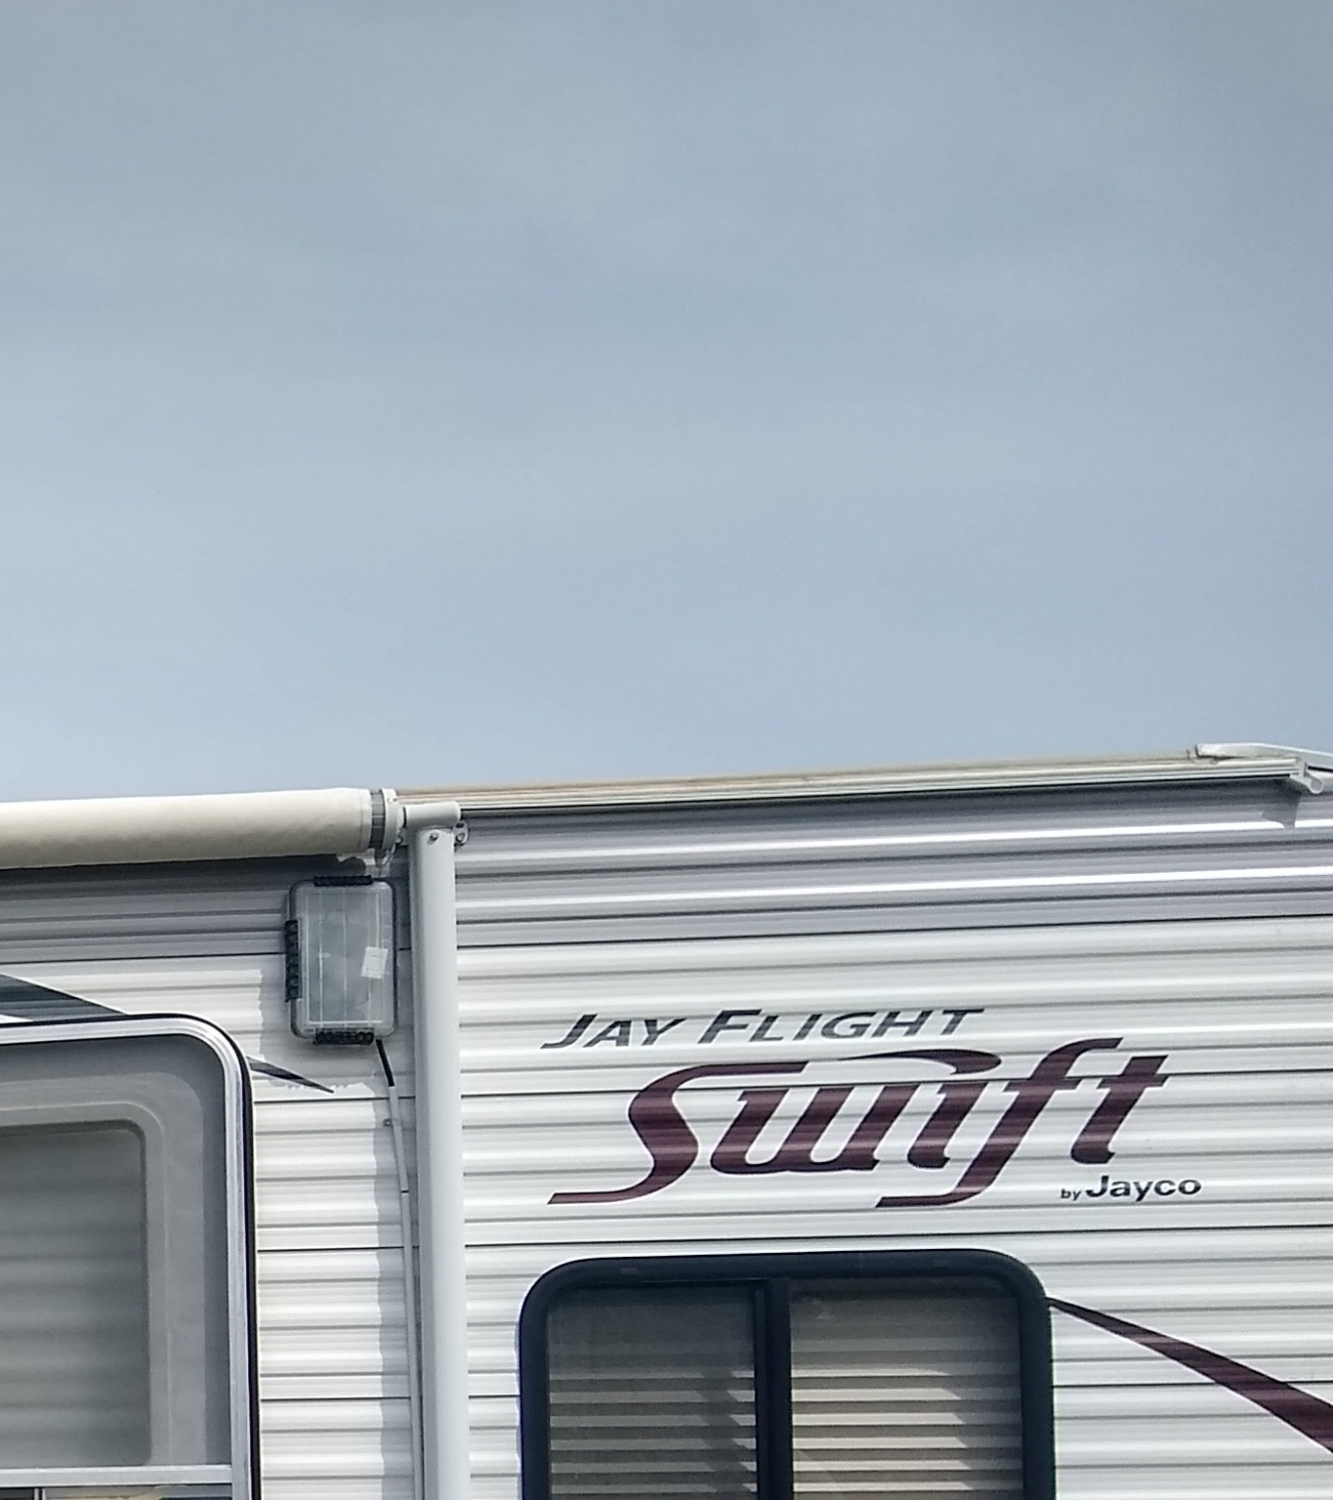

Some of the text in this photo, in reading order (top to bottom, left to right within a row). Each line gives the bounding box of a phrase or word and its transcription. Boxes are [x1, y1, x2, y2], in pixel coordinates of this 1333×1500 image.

[540, 1008, 985, 1049] JAY FLIGHT
[547, 1037, 1167, 1208] Swift
[1060, 1175, 1202, 1202] by Jayco
